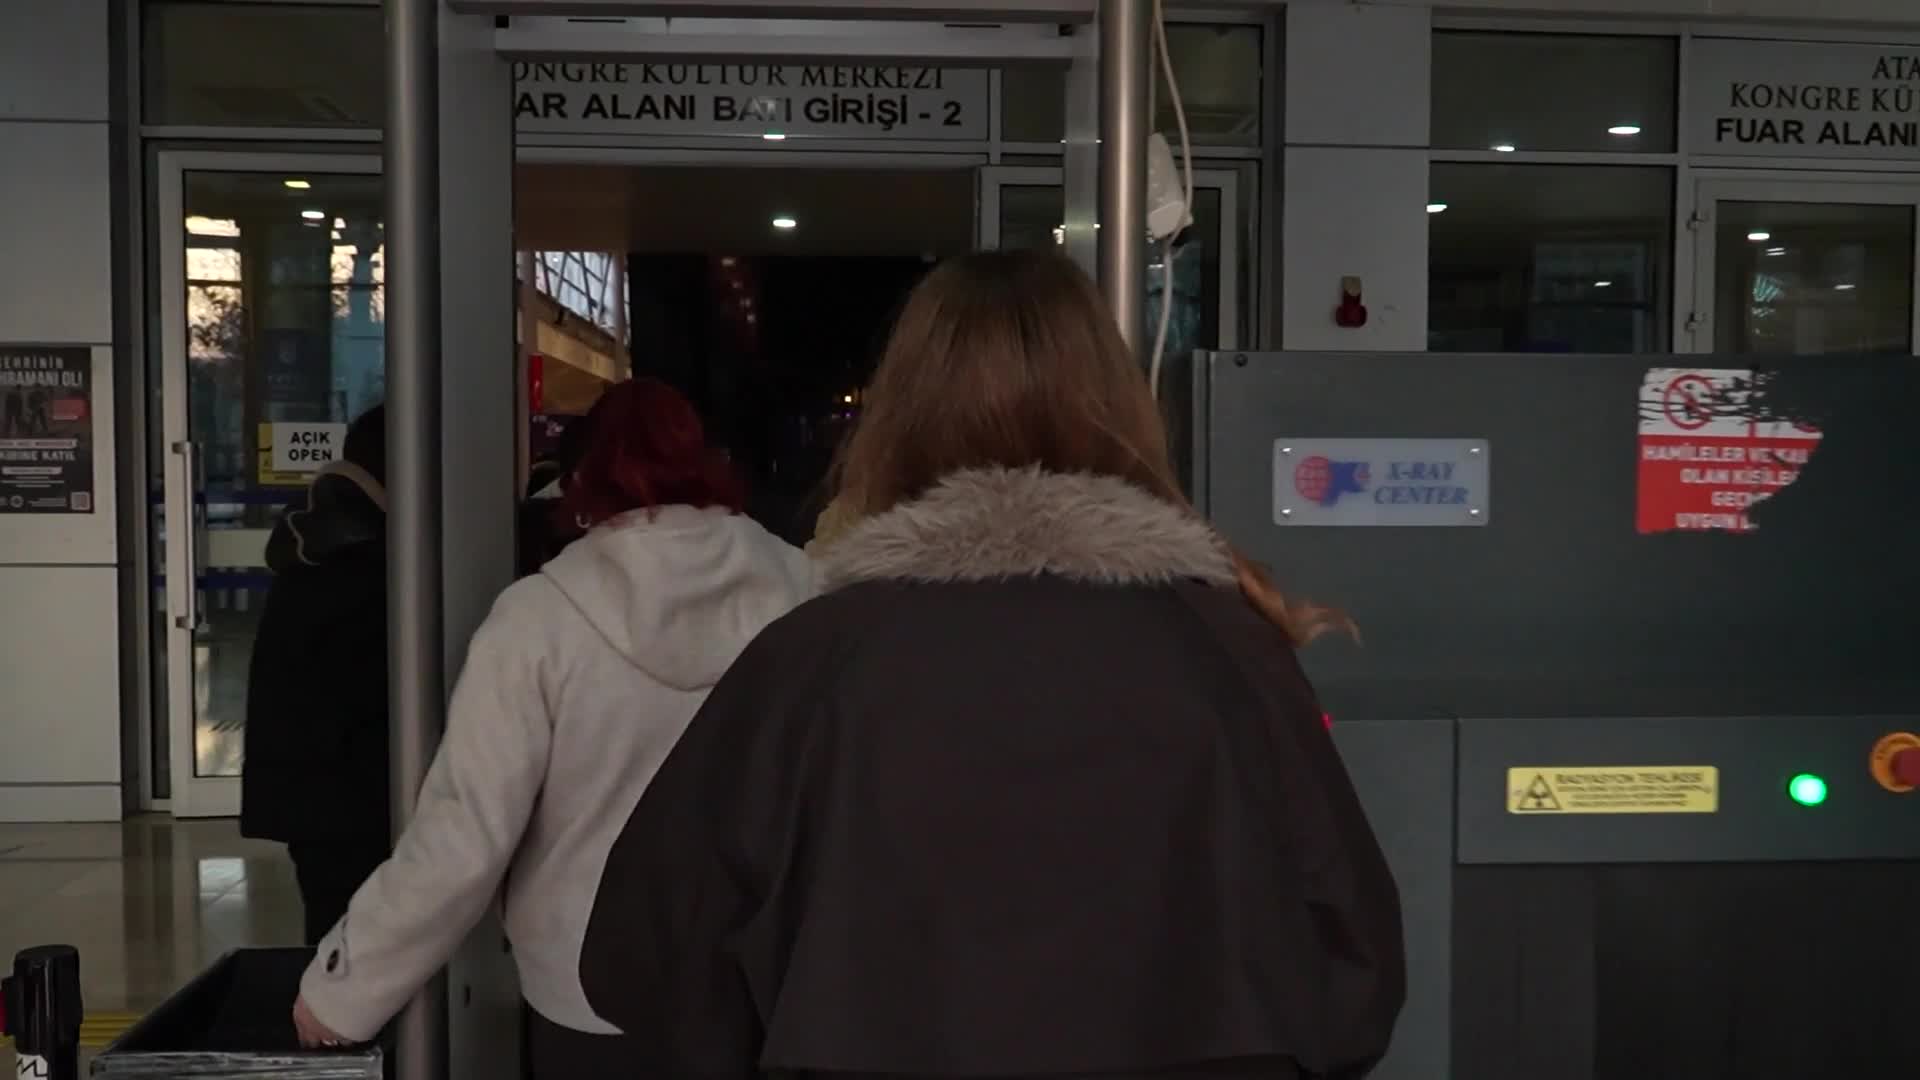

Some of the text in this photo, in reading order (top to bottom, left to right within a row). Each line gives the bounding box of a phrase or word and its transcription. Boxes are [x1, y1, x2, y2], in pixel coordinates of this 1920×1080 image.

[1730, 83, 1862, 112] KONGRE
[581, 94, 696, 121] ALANI
[713, 96, 792, 122] BATI
[803, 93, 908, 131] GİRİŞİ
[943, 101, 962, 127] 2
[1715, 118, 1919, 147] FUAR ALANI
[290, 431, 331, 447] AÇIK
[288, 448, 333, 462] OPEN
[1388, 461, 1456, 480] X-RAY
[1680, 468, 1730, 484] OLAN
[1374, 485, 1469, 505] CENTER
